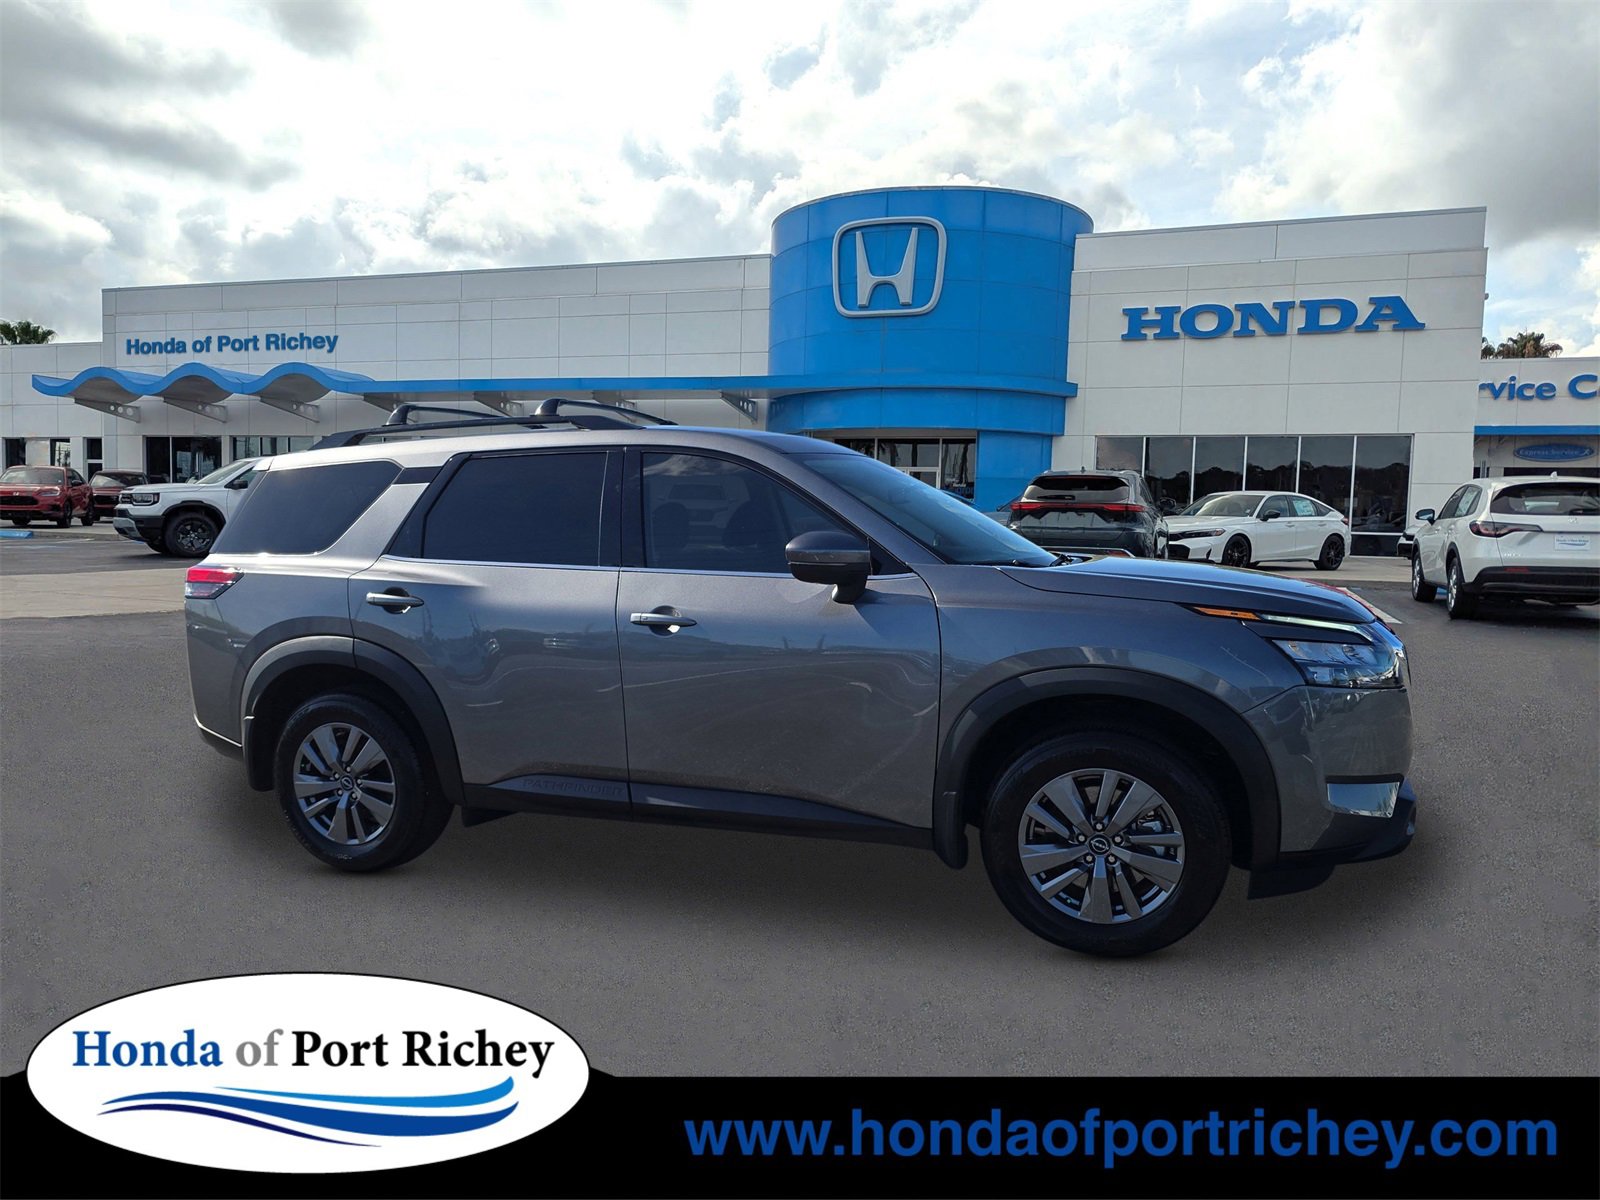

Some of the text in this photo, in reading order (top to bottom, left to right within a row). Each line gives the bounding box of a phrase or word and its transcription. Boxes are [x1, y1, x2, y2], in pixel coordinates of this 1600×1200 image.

[1120, 295, 1425, 341] HONDA
[125, 332, 338, 355] Honda of Port Richey
[1567, 373, 1600, 400] C
